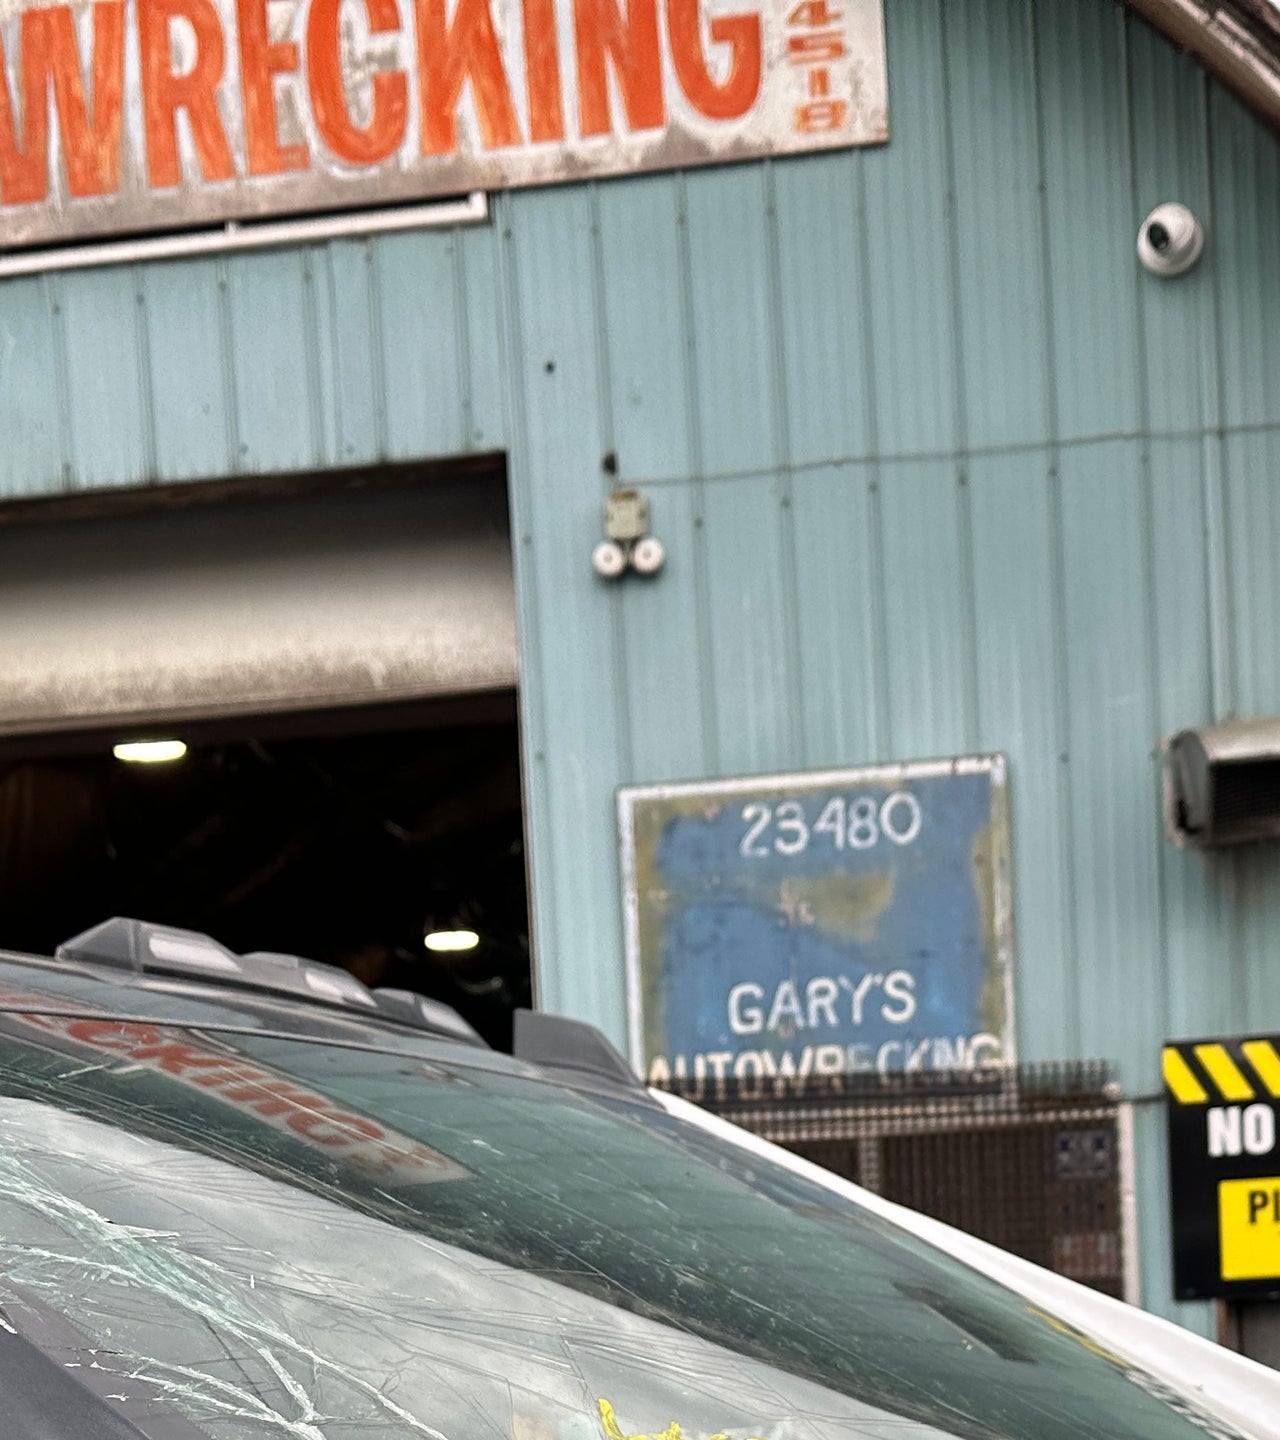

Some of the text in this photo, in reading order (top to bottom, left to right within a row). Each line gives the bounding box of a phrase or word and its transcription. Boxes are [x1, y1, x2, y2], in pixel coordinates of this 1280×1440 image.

[739, 790, 922, 857] 23480
[728, 969, 917, 1035] GARY'S
[1207, 1103, 1275, 1156] NO
